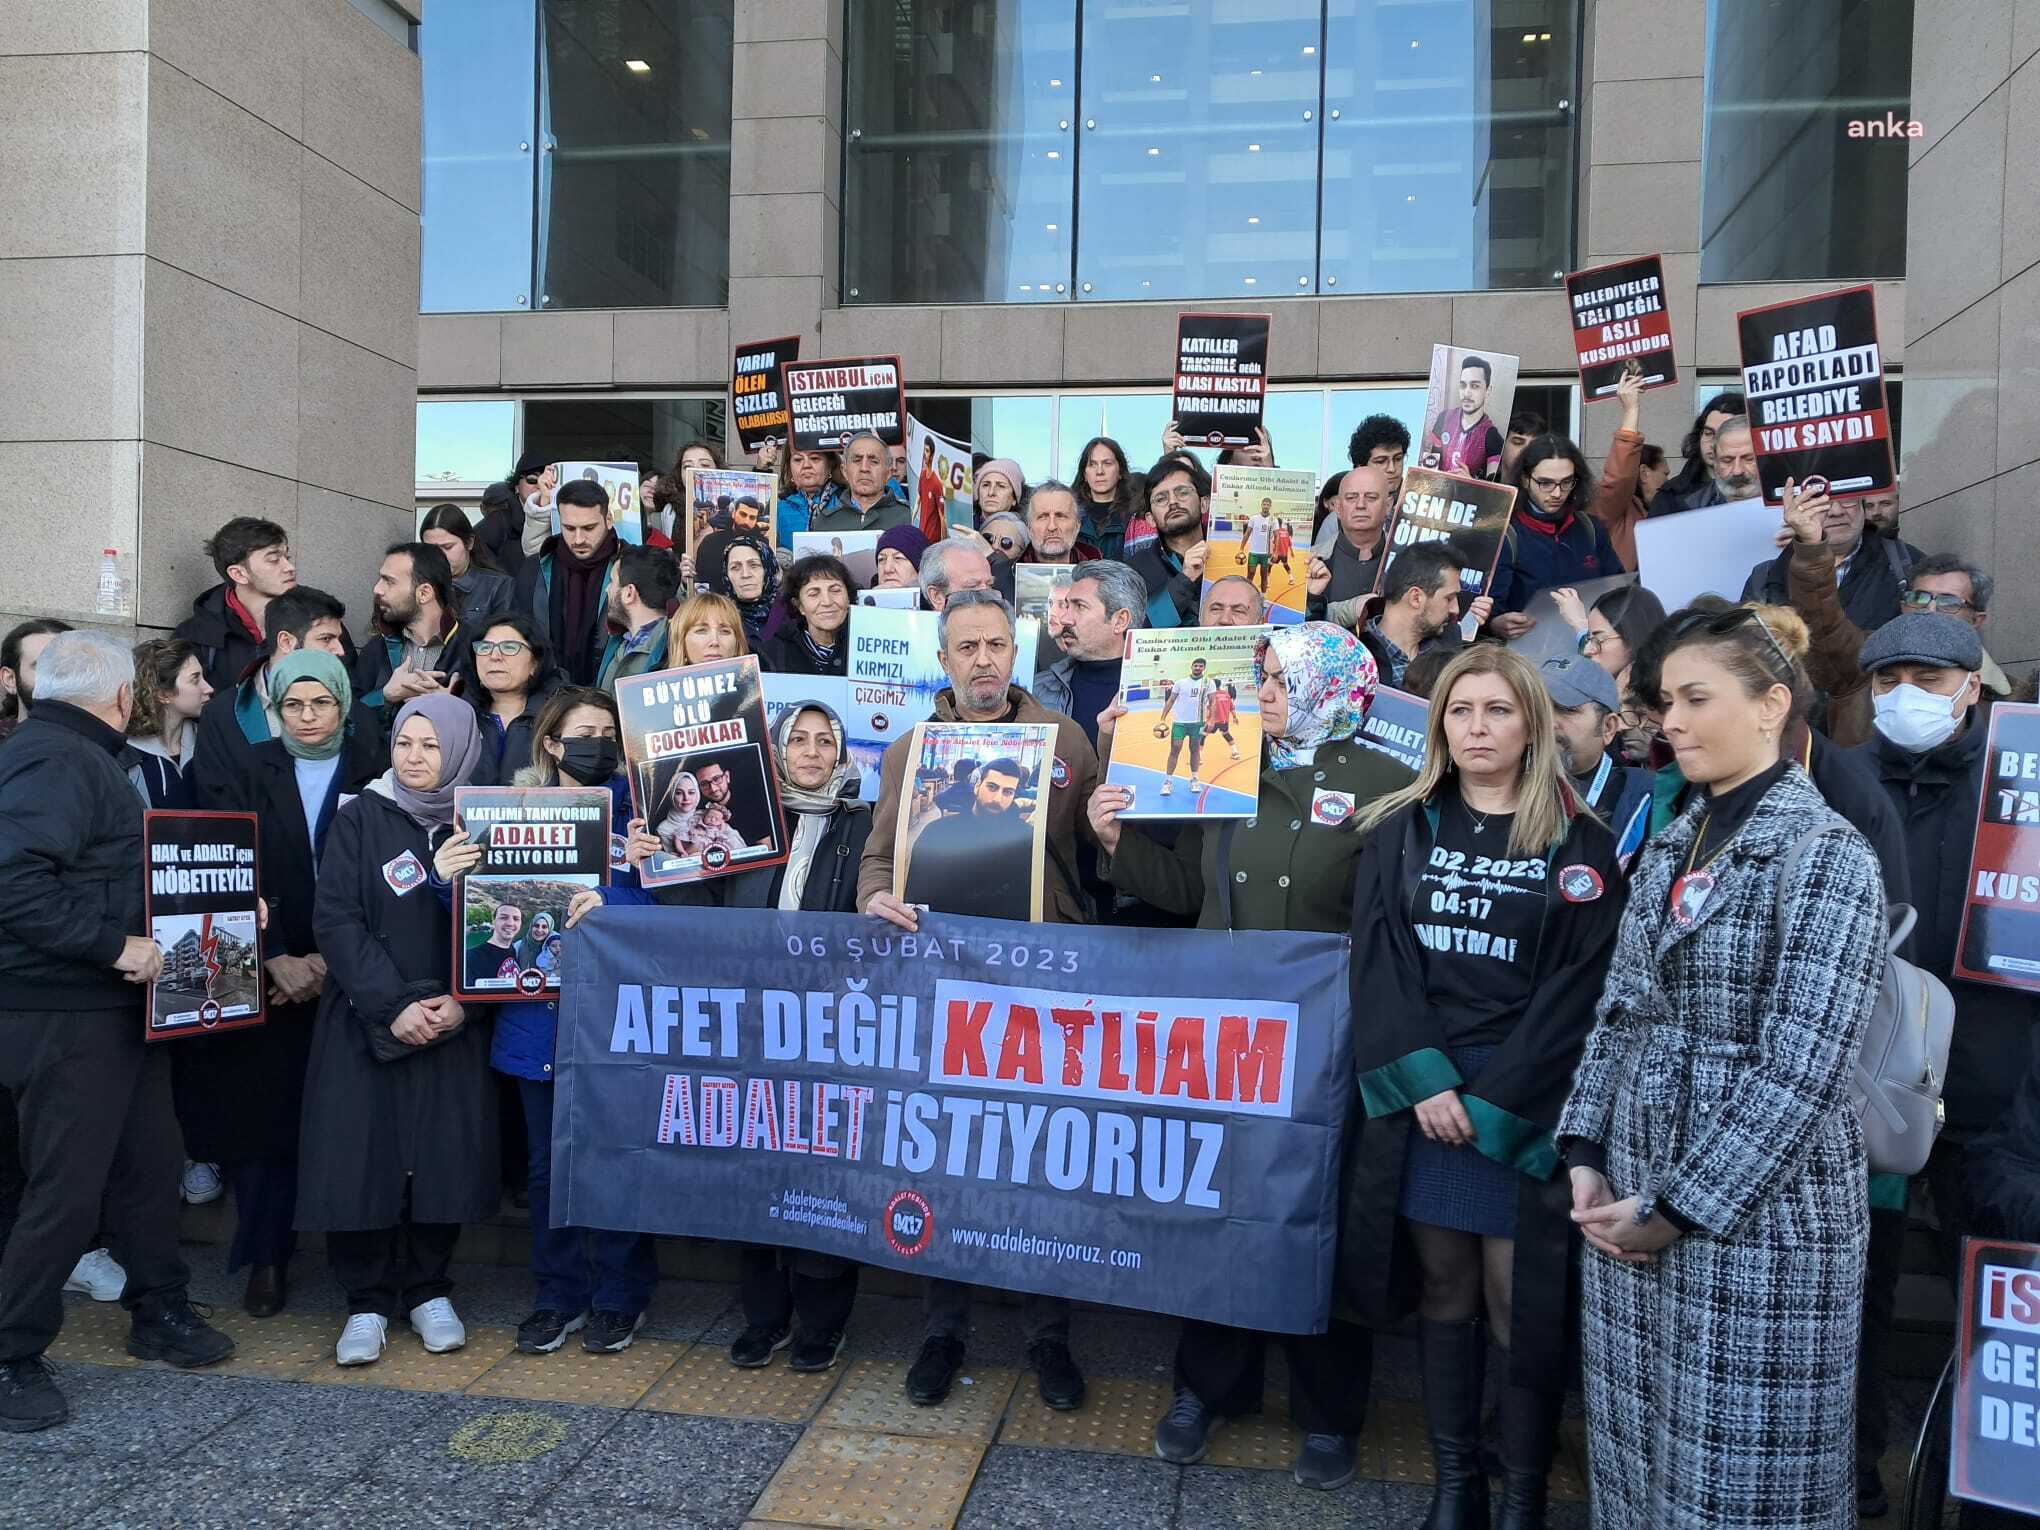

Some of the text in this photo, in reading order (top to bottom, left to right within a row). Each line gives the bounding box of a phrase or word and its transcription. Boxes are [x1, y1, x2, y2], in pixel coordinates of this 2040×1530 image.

[1573, 276, 1659, 308] BELEDİYELER
[1577, 294, 1662, 327] TALİ DEĞİL
[1181, 337, 1239, 354] KATİLLER
[1602, 319, 1641, 344] ASLİ
[1773, 324, 1837, 361] AFAD
[736, 352, 775, 373] YARIN
[1579, 334, 1670, 365] KUSURLUDUR
[735, 373, 767, 394] ÖLEN
[790, 367, 894, 392] İSTANBUL İÇİN
[1178, 376, 1261, 393] OLASI KASTLA
[1749, 350, 1875, 394] RAPORLADI
[735, 391, 778, 414] SİZLER
[792, 392, 847, 414] GELECEĞİ
[1177, 397, 1260, 414] YARGILANSIN
[1762, 385, 1862, 425] BELEDİYE
[793, 411, 898, 434] DEĞİŞTİREBİLİRİZ
[1760, 415, 1874, 451] YOK SAYDI
[1402, 491, 1478, 527] SEN DE
[856, 636, 909, 656] DEPREM
[856, 660, 903, 678] KIRMIZI
[642, 671, 738, 707] BÜYÜMEZ
[855, 687, 906, 707] ÇİZGİMİZ
[672, 700, 712, 728] ÖLÜ
[650, 720, 743, 755] ÇOCUKLAR
[1363, 716, 1425, 750] ADALET
[1999, 751, 2040, 779] BE
[466, 807, 600, 821] KATİLİMİ TANIYORUM
[492, 826, 573, 846] ADALET
[151, 844, 254, 865] HAK VE ADALET İÇİN
[487, 849, 579, 865] İSTİYORUM
[151, 864, 254, 895] NÖBETTEYİZ!
[1430, 890, 1493, 920] 04:17
[787, 935, 1080, 975] 06 ŞUBAT 2023
[609, 977, 1288, 1105] AFET DEĞİL KATLİAM
[657, 1074, 874, 1162] ADALET
[881, 1089, 1225, 1209] İSTİYORUZ
[1982, 1339, 2040, 1390] GE
[1981, 1395, 2040, 1448] DE
